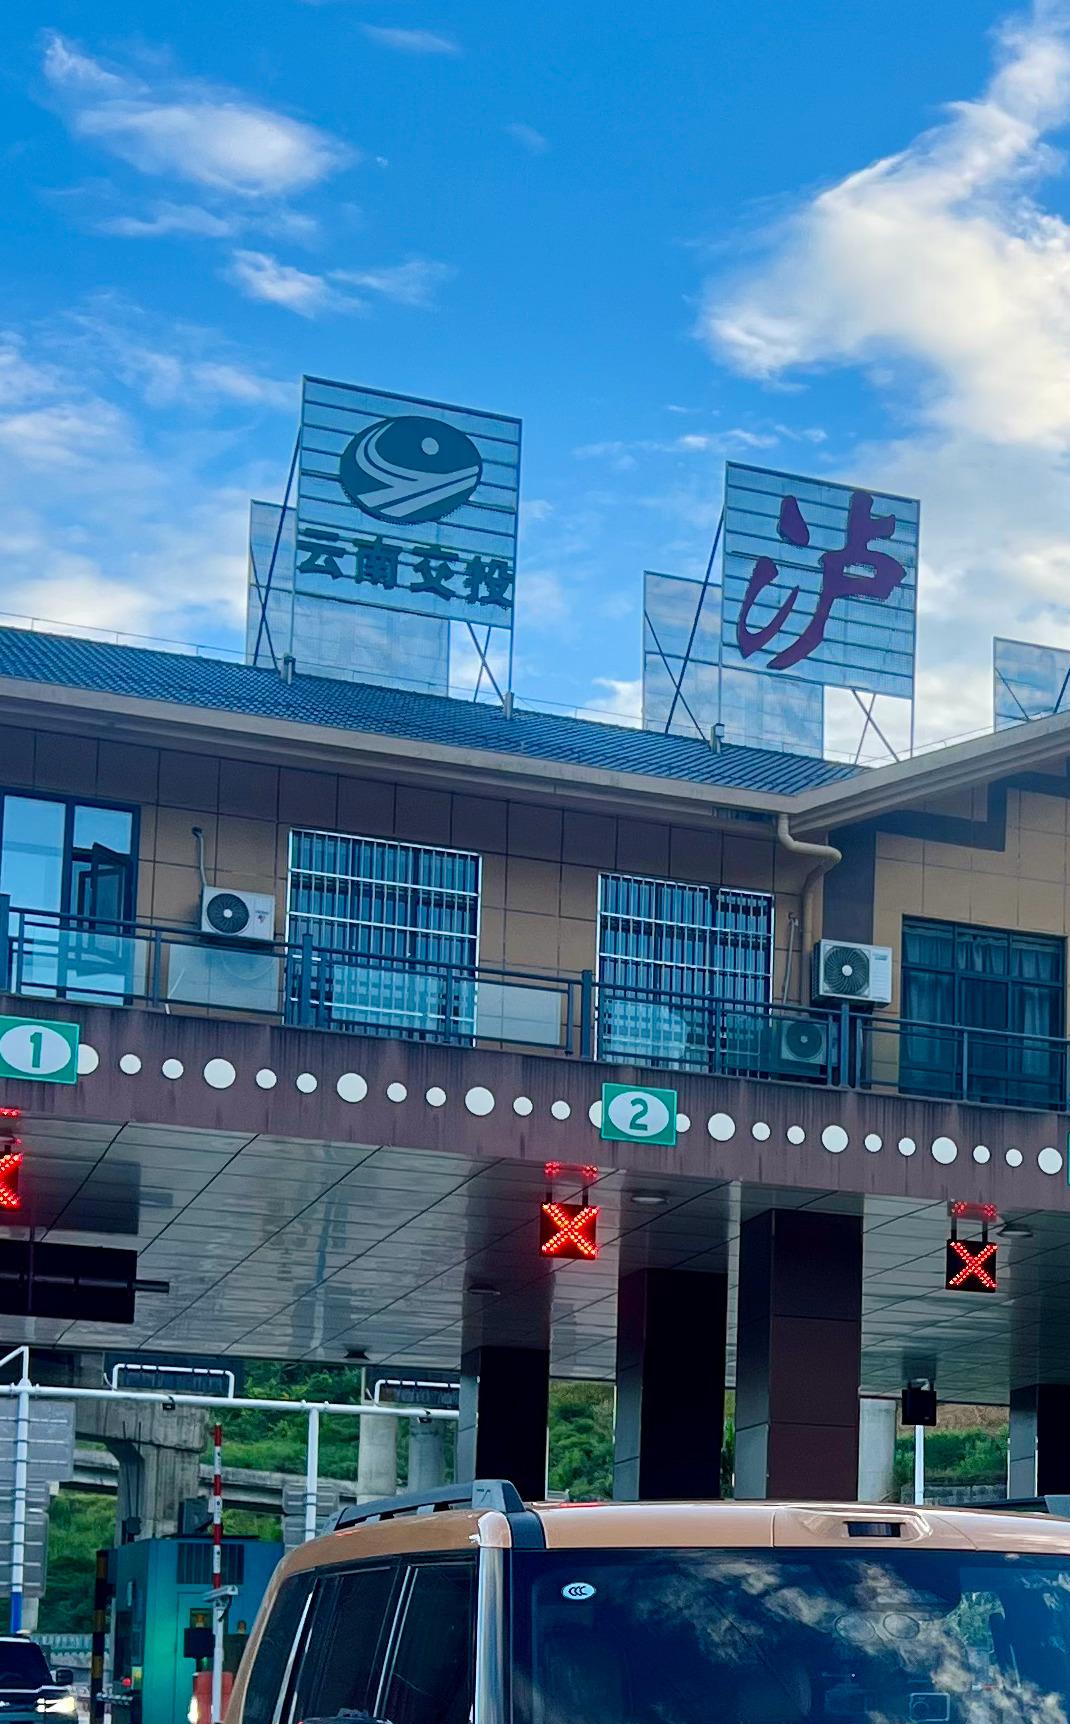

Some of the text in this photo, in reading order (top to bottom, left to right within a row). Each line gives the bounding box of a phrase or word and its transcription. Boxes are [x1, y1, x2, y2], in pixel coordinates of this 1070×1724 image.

[296, 527, 514, 611] 云南交投
[31, 1032, 42, 1067] 1
[629, 1098, 648, 1131] 2
